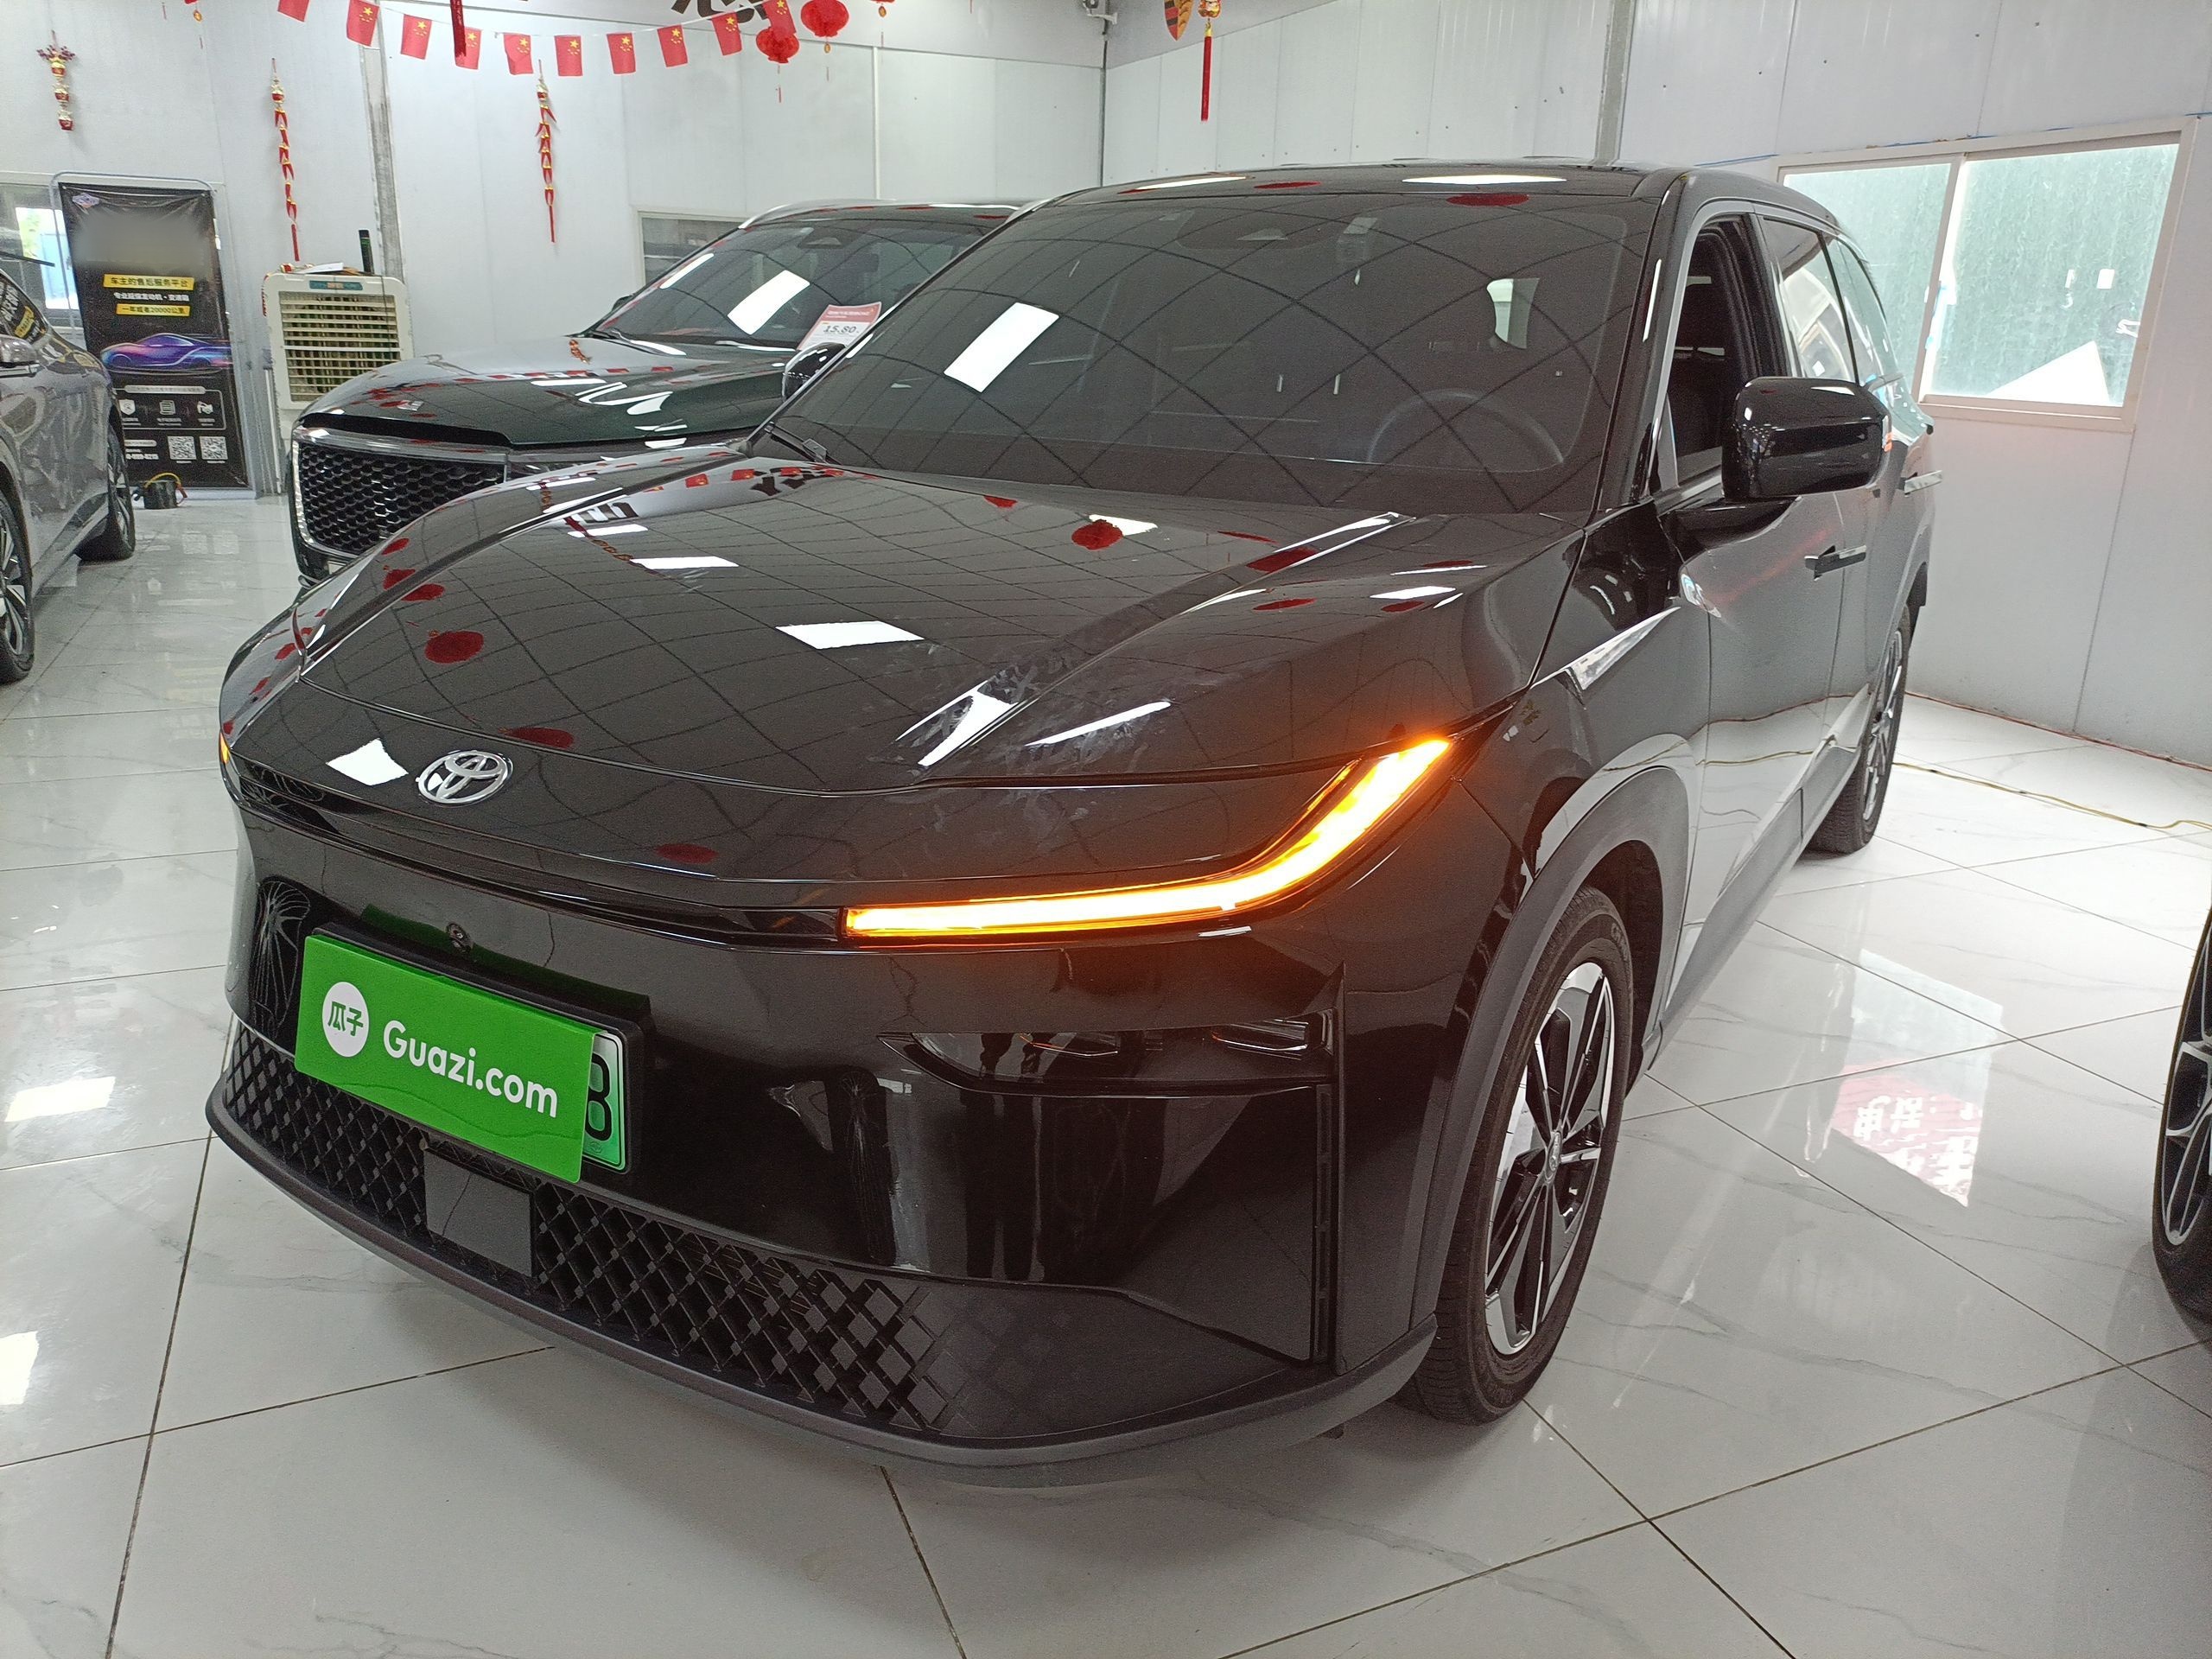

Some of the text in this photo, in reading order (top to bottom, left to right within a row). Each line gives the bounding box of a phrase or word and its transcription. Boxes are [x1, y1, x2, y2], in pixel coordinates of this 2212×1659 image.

[111, 276, 188, 287] 车主的售后服务平台
[327, 1001, 364, 1036] 瓜子
[384, 1020, 557, 1118] Guazi.com
[584, 1052, 613, 1141] 8
